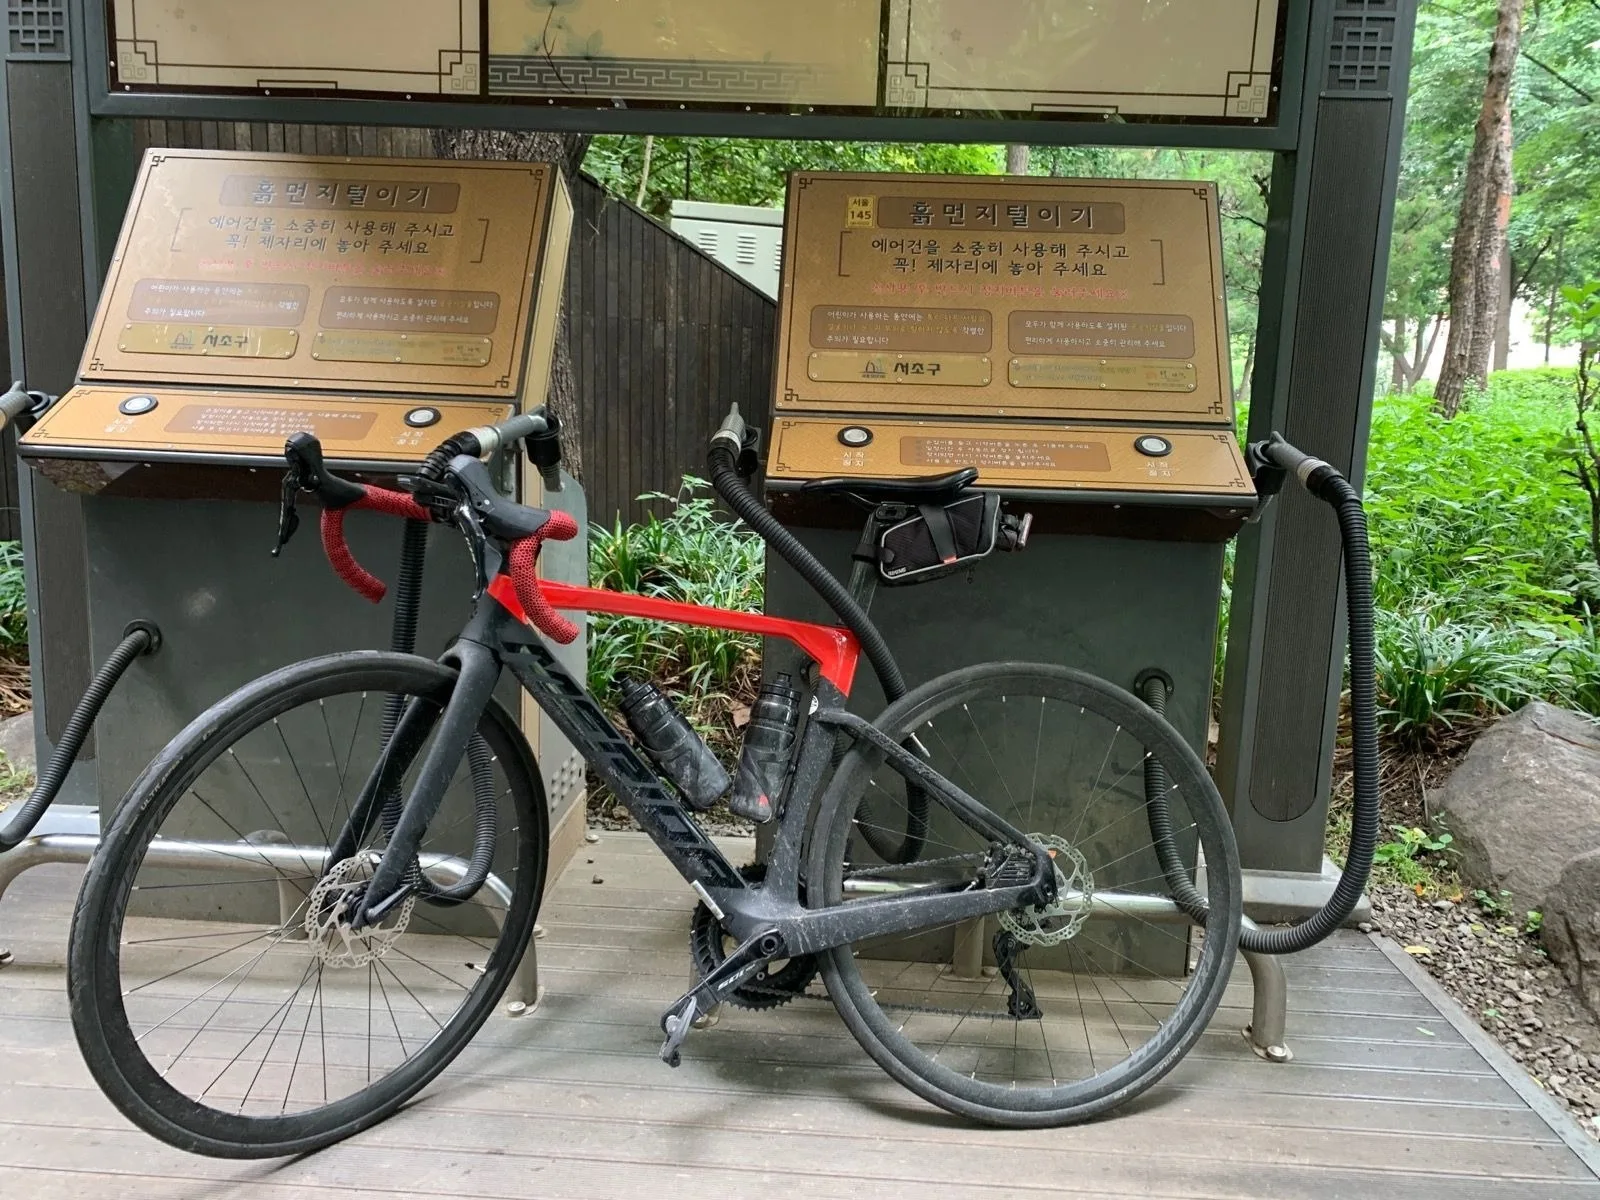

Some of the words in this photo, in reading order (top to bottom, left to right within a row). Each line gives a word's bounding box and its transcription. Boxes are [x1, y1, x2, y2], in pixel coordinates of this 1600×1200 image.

[252, 180, 430, 208] 흙먼지털이기
[852, 198, 870, 207] 서울
[850, 210, 872, 220] 145
[909, 201, 1095, 229] 흙먼지털이기
[208, 215, 276, 232] 에어건을
[283, 217, 336, 235] 소중히
[343, 220, 397, 237] 사용해
[403, 222, 455, 238] 주시고
[225, 235, 249, 250] 꼭!
[259, 235, 327, 252] 제자리에
[336, 237, 370, 253] 놓아
[377, 239, 430, 255] 주세요
[871, 239, 941, 255] 에어건을
[951, 241, 1003, 257] 소중히
[1012, 242, 1067, 258] 사용해
[1075, 243, 1130, 259] 주시고
[892, 257, 916, 273] 꼭!
[927, 258, 999, 275] 제자리에
[1007, 260, 1043, 276] 놓아
[1052, 262, 1108, 277] 주세요
[827, 311, 857, 320] 어린이가
[860, 312, 890, 322] 사용하는
[1025, 320, 1047, 329] 모두가
[1067, 322, 1103, 331] 사용하도록
[852, 336, 890, 346] 필요합니다
[893, 362, 941, 377] 서초구
